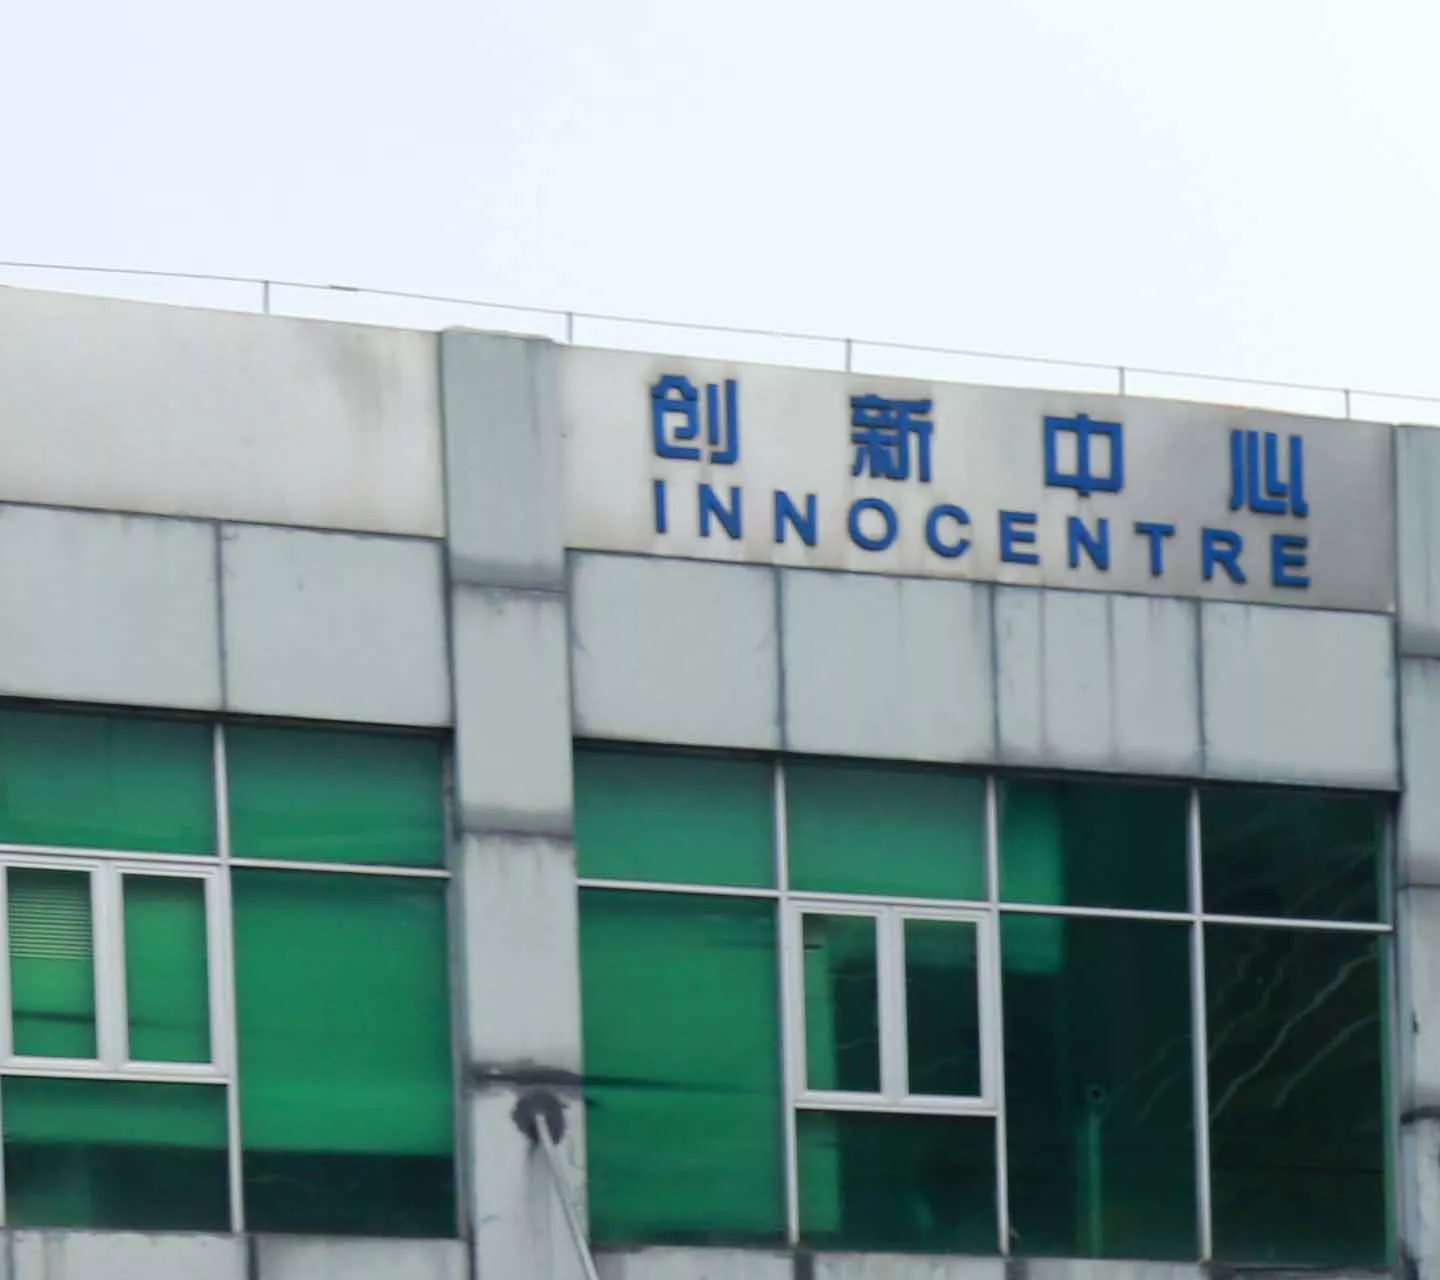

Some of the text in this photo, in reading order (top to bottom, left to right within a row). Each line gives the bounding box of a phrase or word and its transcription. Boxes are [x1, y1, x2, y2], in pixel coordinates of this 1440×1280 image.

[650, 374, 1309, 518] 创新中心
[653, 479, 1311, 589] INNOCENTRE
